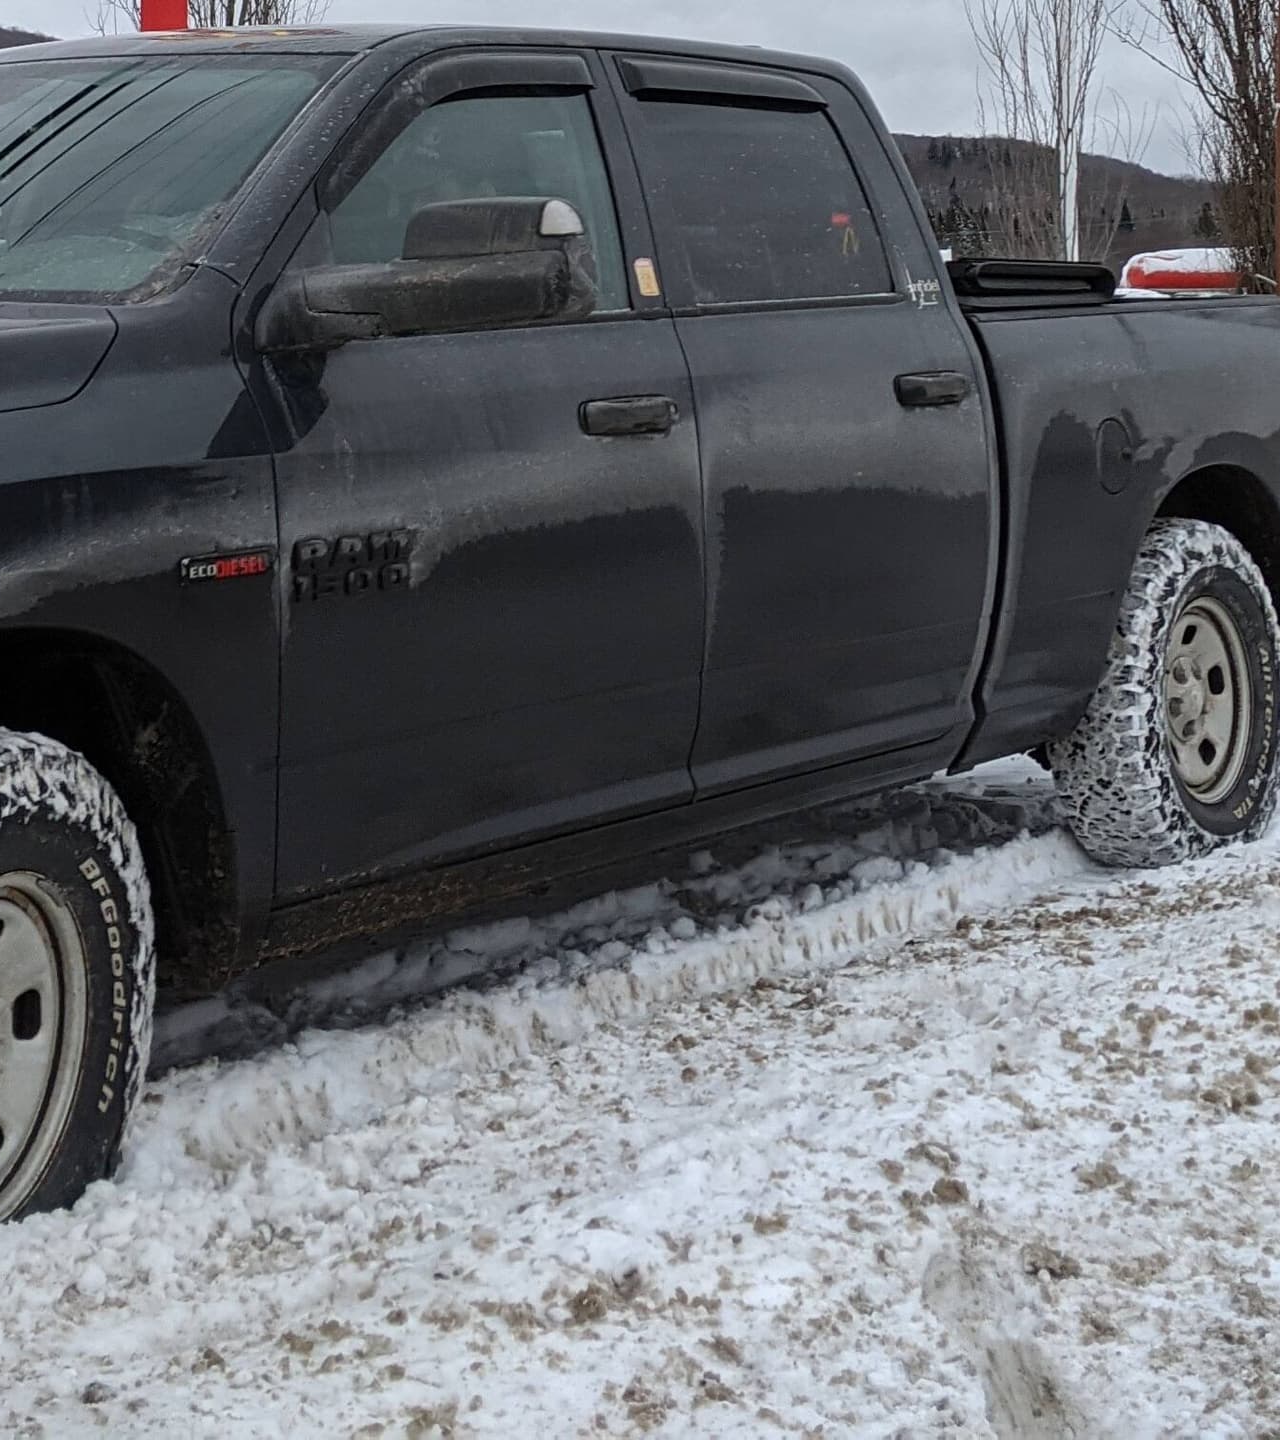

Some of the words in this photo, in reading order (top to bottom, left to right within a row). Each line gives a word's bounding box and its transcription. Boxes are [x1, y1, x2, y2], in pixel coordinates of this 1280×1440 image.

[291, 530, 413, 572] RAM
[293, 562, 409, 602] 1500
[78, 856, 127, 1114] BFGoodrich
